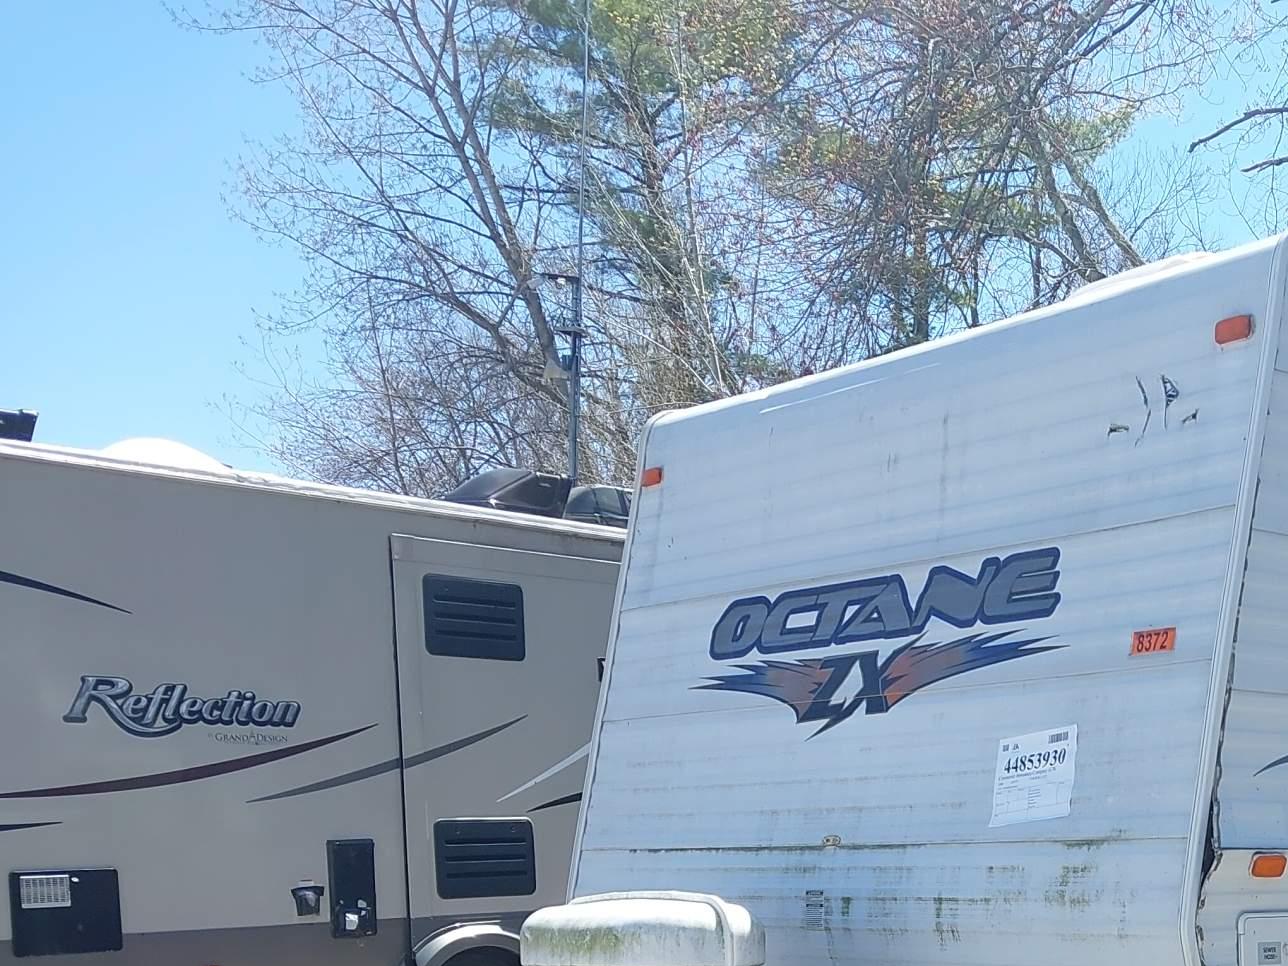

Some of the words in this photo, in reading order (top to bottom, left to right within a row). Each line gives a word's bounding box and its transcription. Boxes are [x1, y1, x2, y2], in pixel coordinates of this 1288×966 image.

[708, 546, 1062, 661] OCTANE
[1136, 631, 1169, 653] 8372
[62, 675, 301, 738] Reflection
[214, 732, 249, 743] GRAND
[256, 733, 288, 743] DESIGN
[1003, 747, 1066, 774] 44853930
